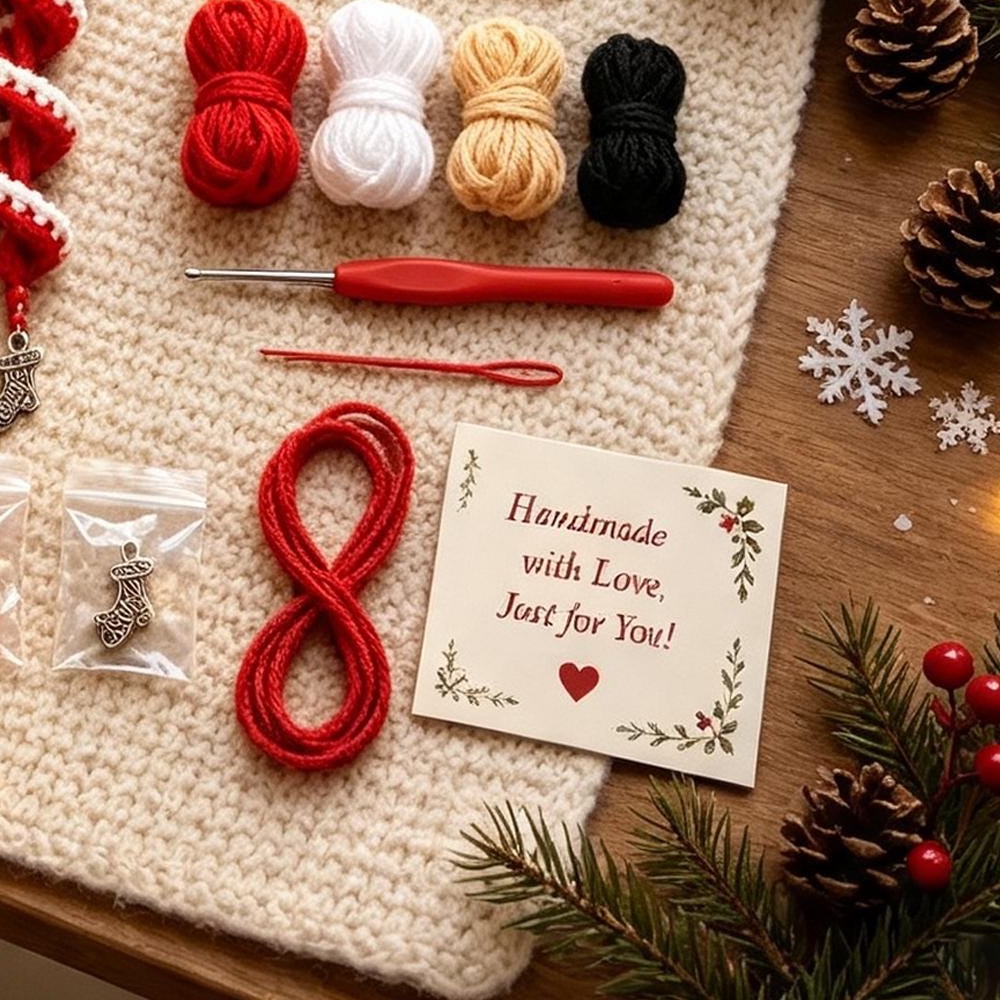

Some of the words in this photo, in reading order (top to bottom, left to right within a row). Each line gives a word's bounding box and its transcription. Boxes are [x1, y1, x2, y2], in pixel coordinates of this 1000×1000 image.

[505, 492, 668, 547] Handmade
[522, 550, 581, 582] with
[590, 557, 665, 603] Love,
[554, 602, 606, 639] for
[613, 612, 676, 650] You!
